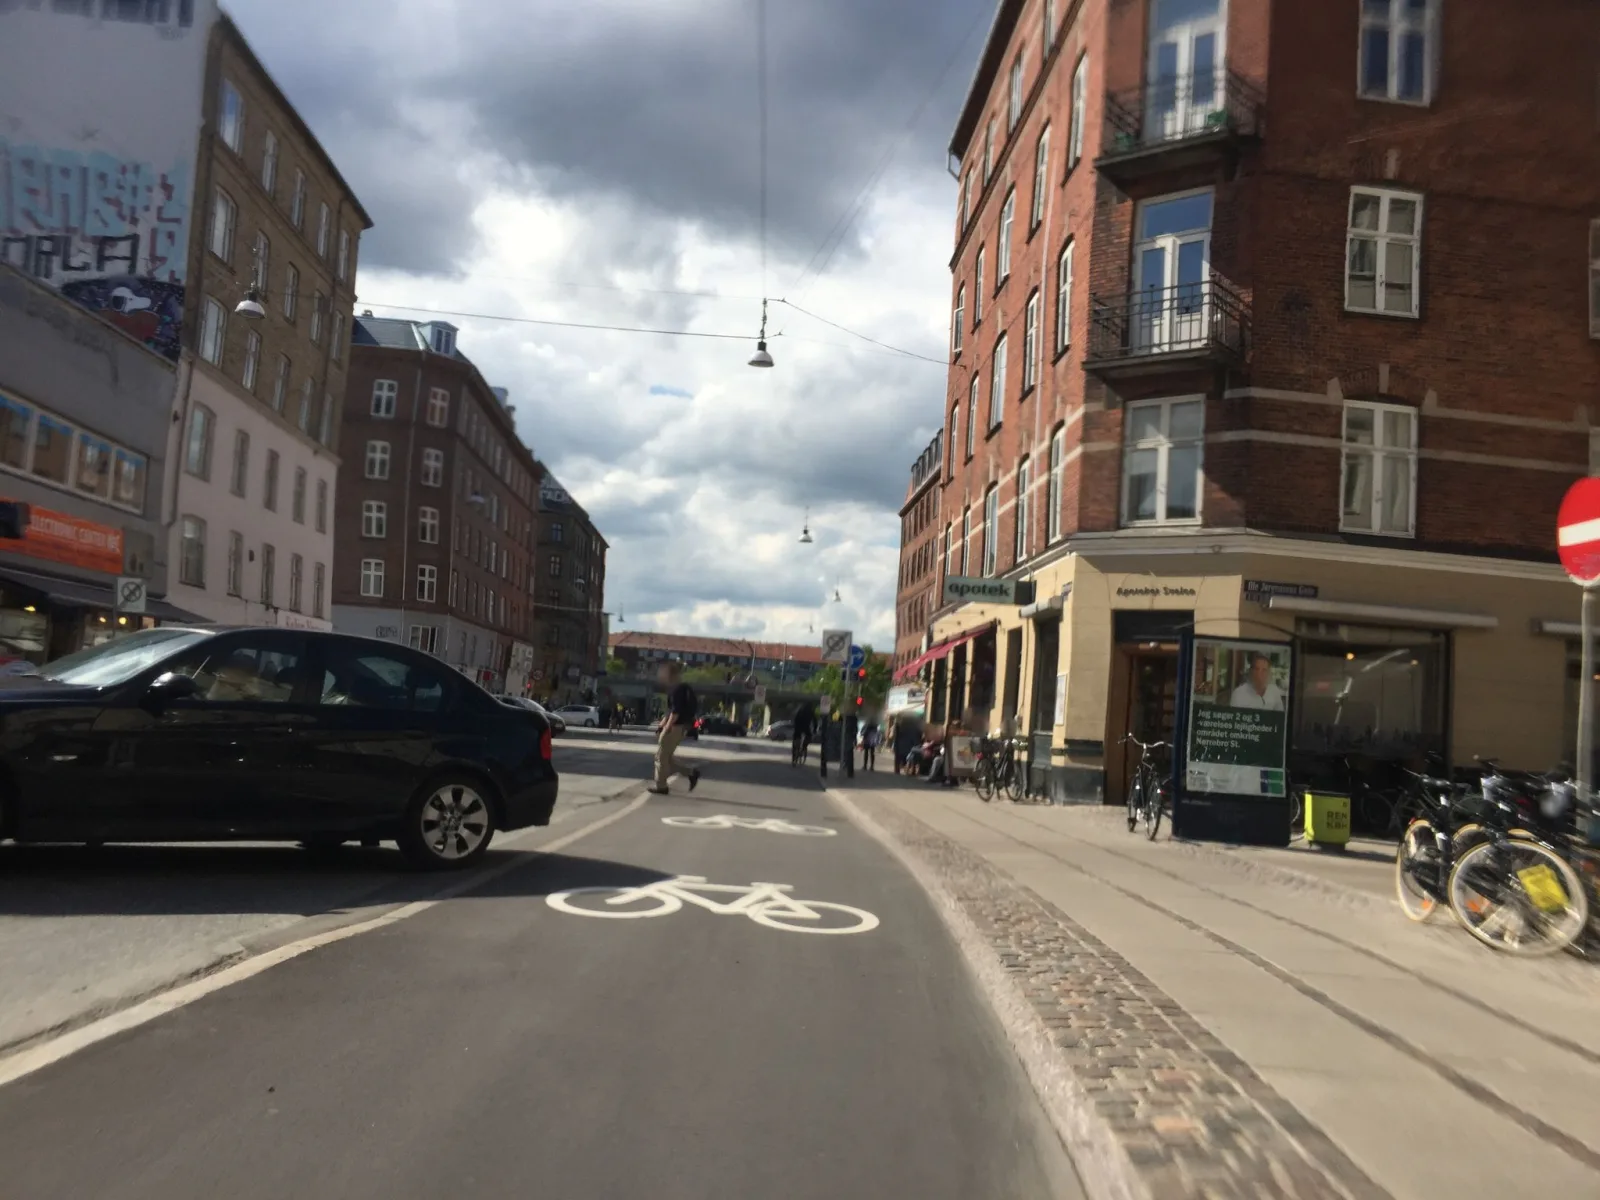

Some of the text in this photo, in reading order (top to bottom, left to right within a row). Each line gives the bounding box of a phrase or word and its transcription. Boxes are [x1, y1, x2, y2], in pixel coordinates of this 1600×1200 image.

[948, 583, 1011, 597] apotek
[1198, 709, 1260, 722] Jeg søger 2 og 3
[1234, 721, 1273, 733] lejligheder
[1196, 728, 1260, 742] området omkring
[1196, 737, 1240, 748] Nørrebro St.
[1326, 811, 1348, 821] REN
